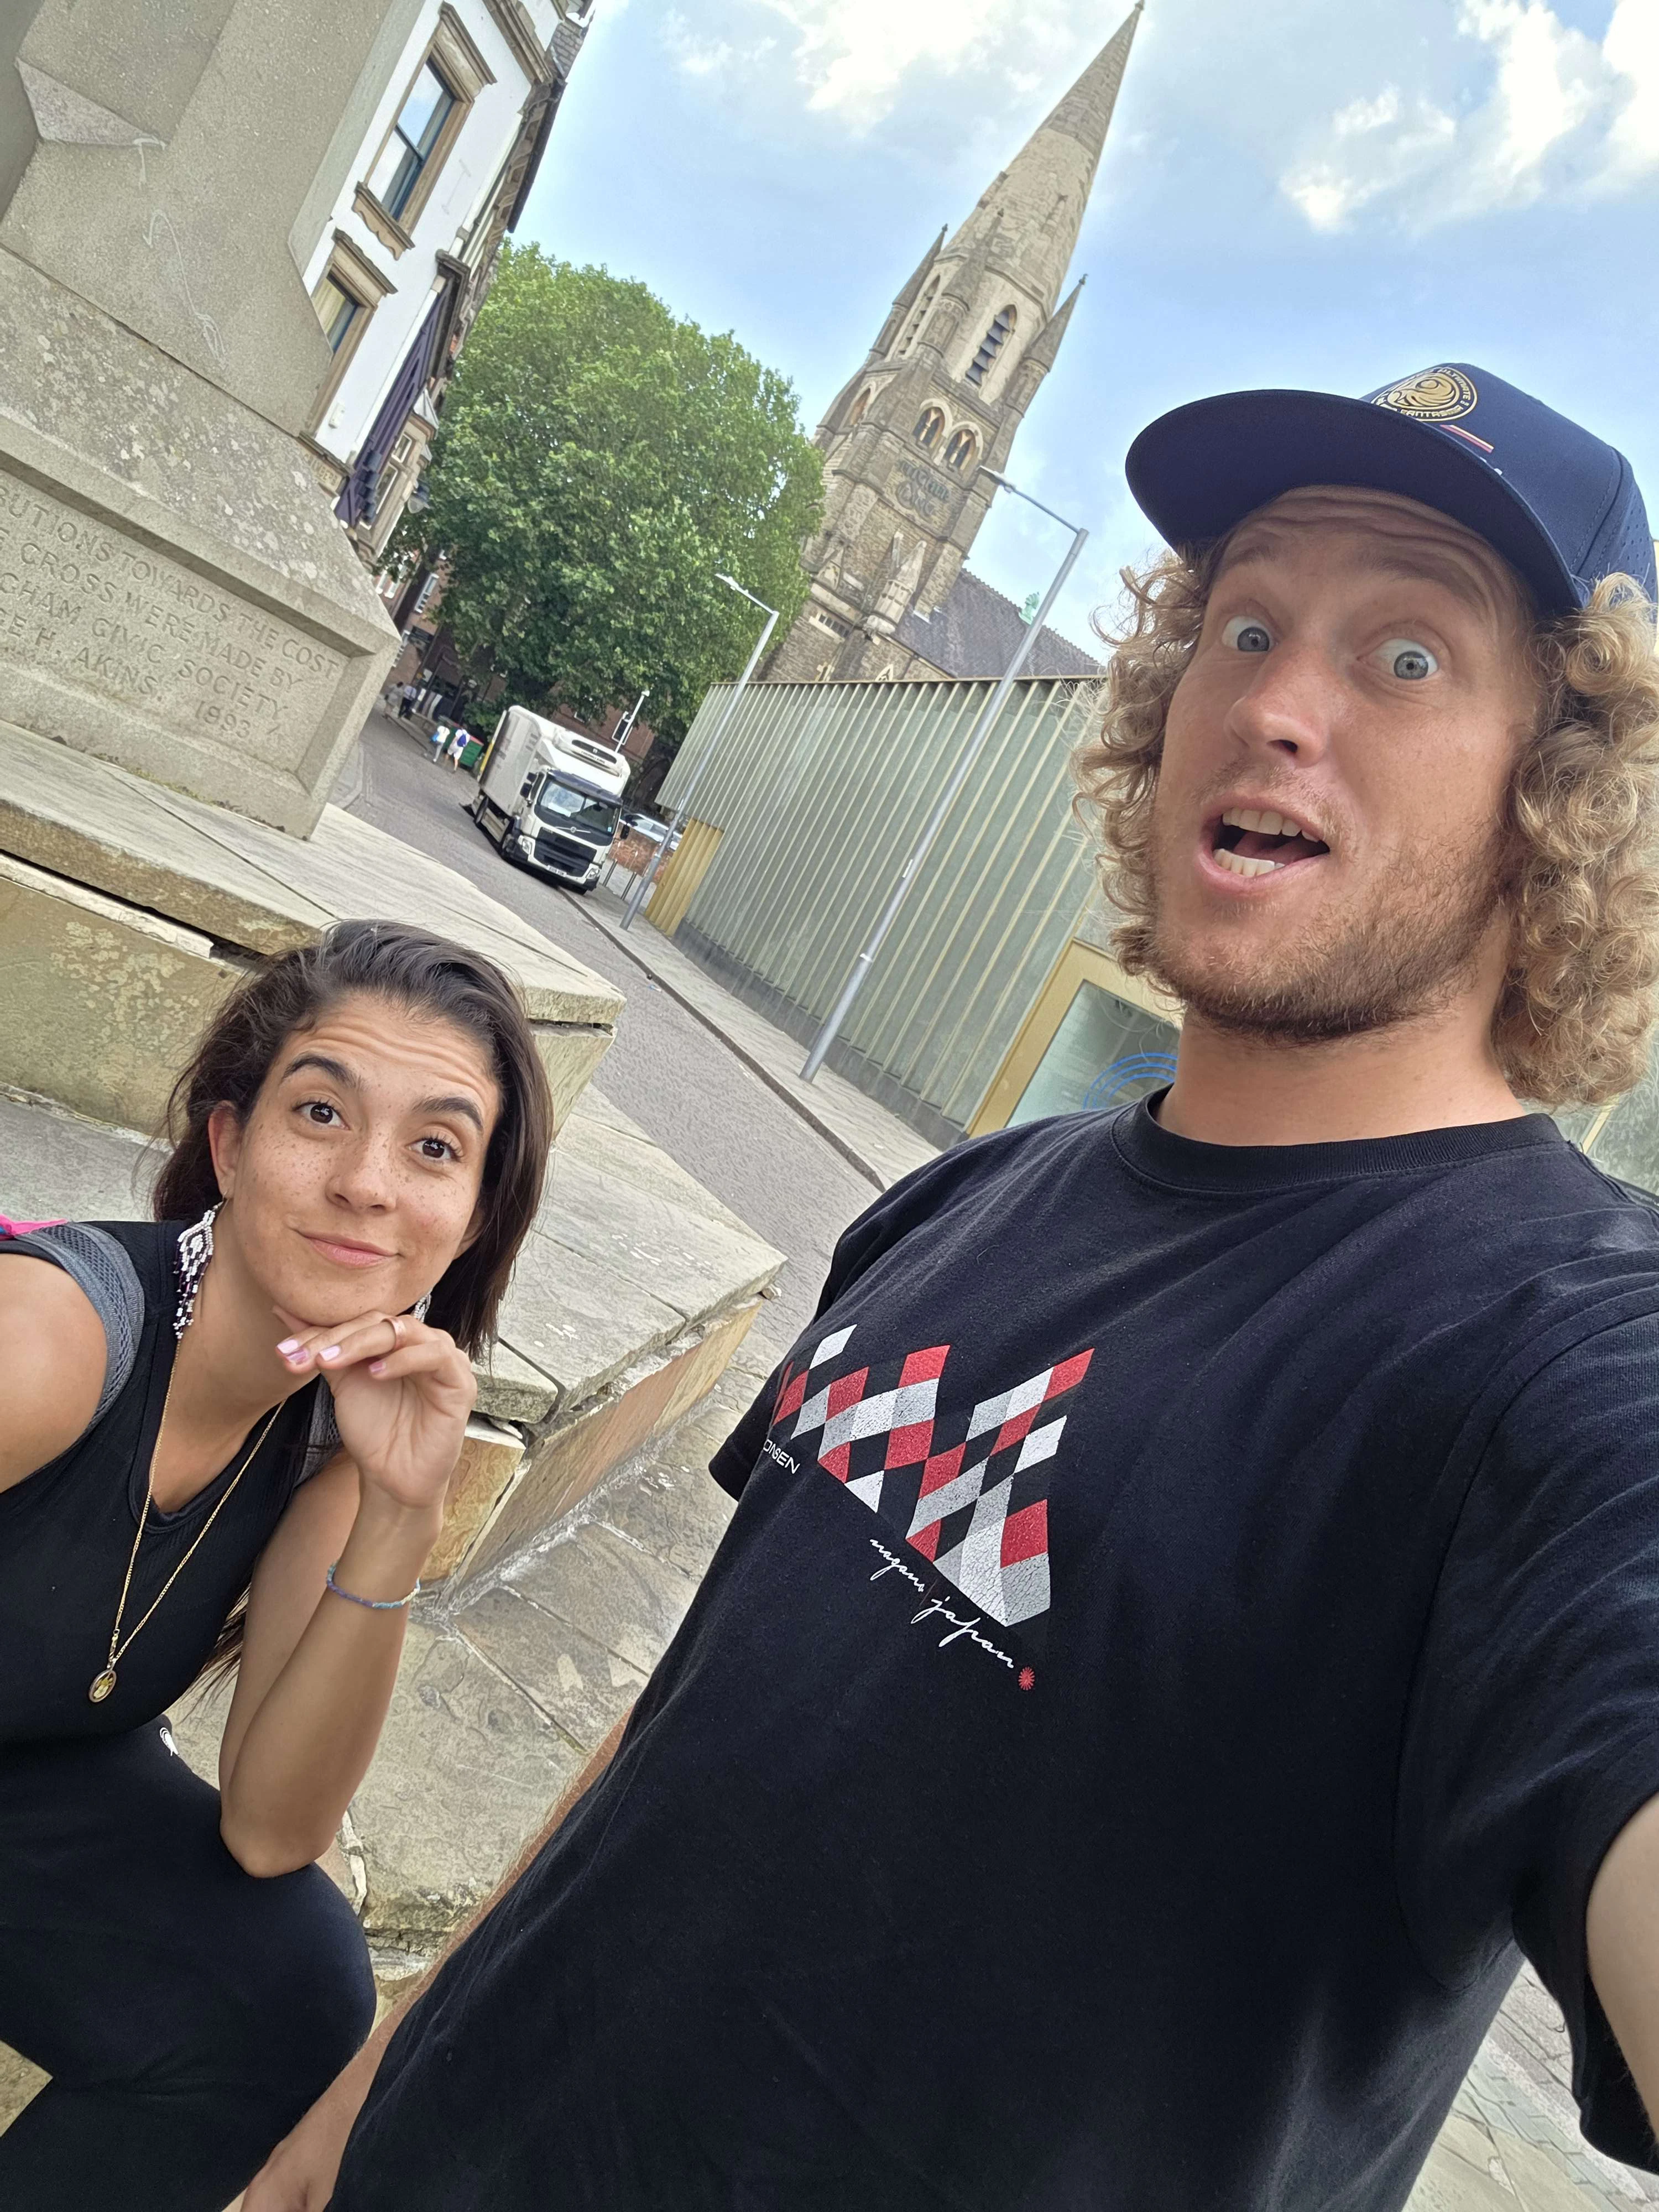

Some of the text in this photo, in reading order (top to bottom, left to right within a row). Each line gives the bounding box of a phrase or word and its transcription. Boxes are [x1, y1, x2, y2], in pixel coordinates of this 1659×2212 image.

[21, 542, 304, 692] CROSS WERE MADE BY
[118, 552, 231, 623] TOWARDS
[238, 612, 279, 650] THE
[282, 639, 340, 679] COST
[92, 618, 166, 664] CIVIC
[178, 659, 289, 719] SOCIETY
[195, 701, 251, 738] 1893
[911, 1596, 1014, 1668] japan
